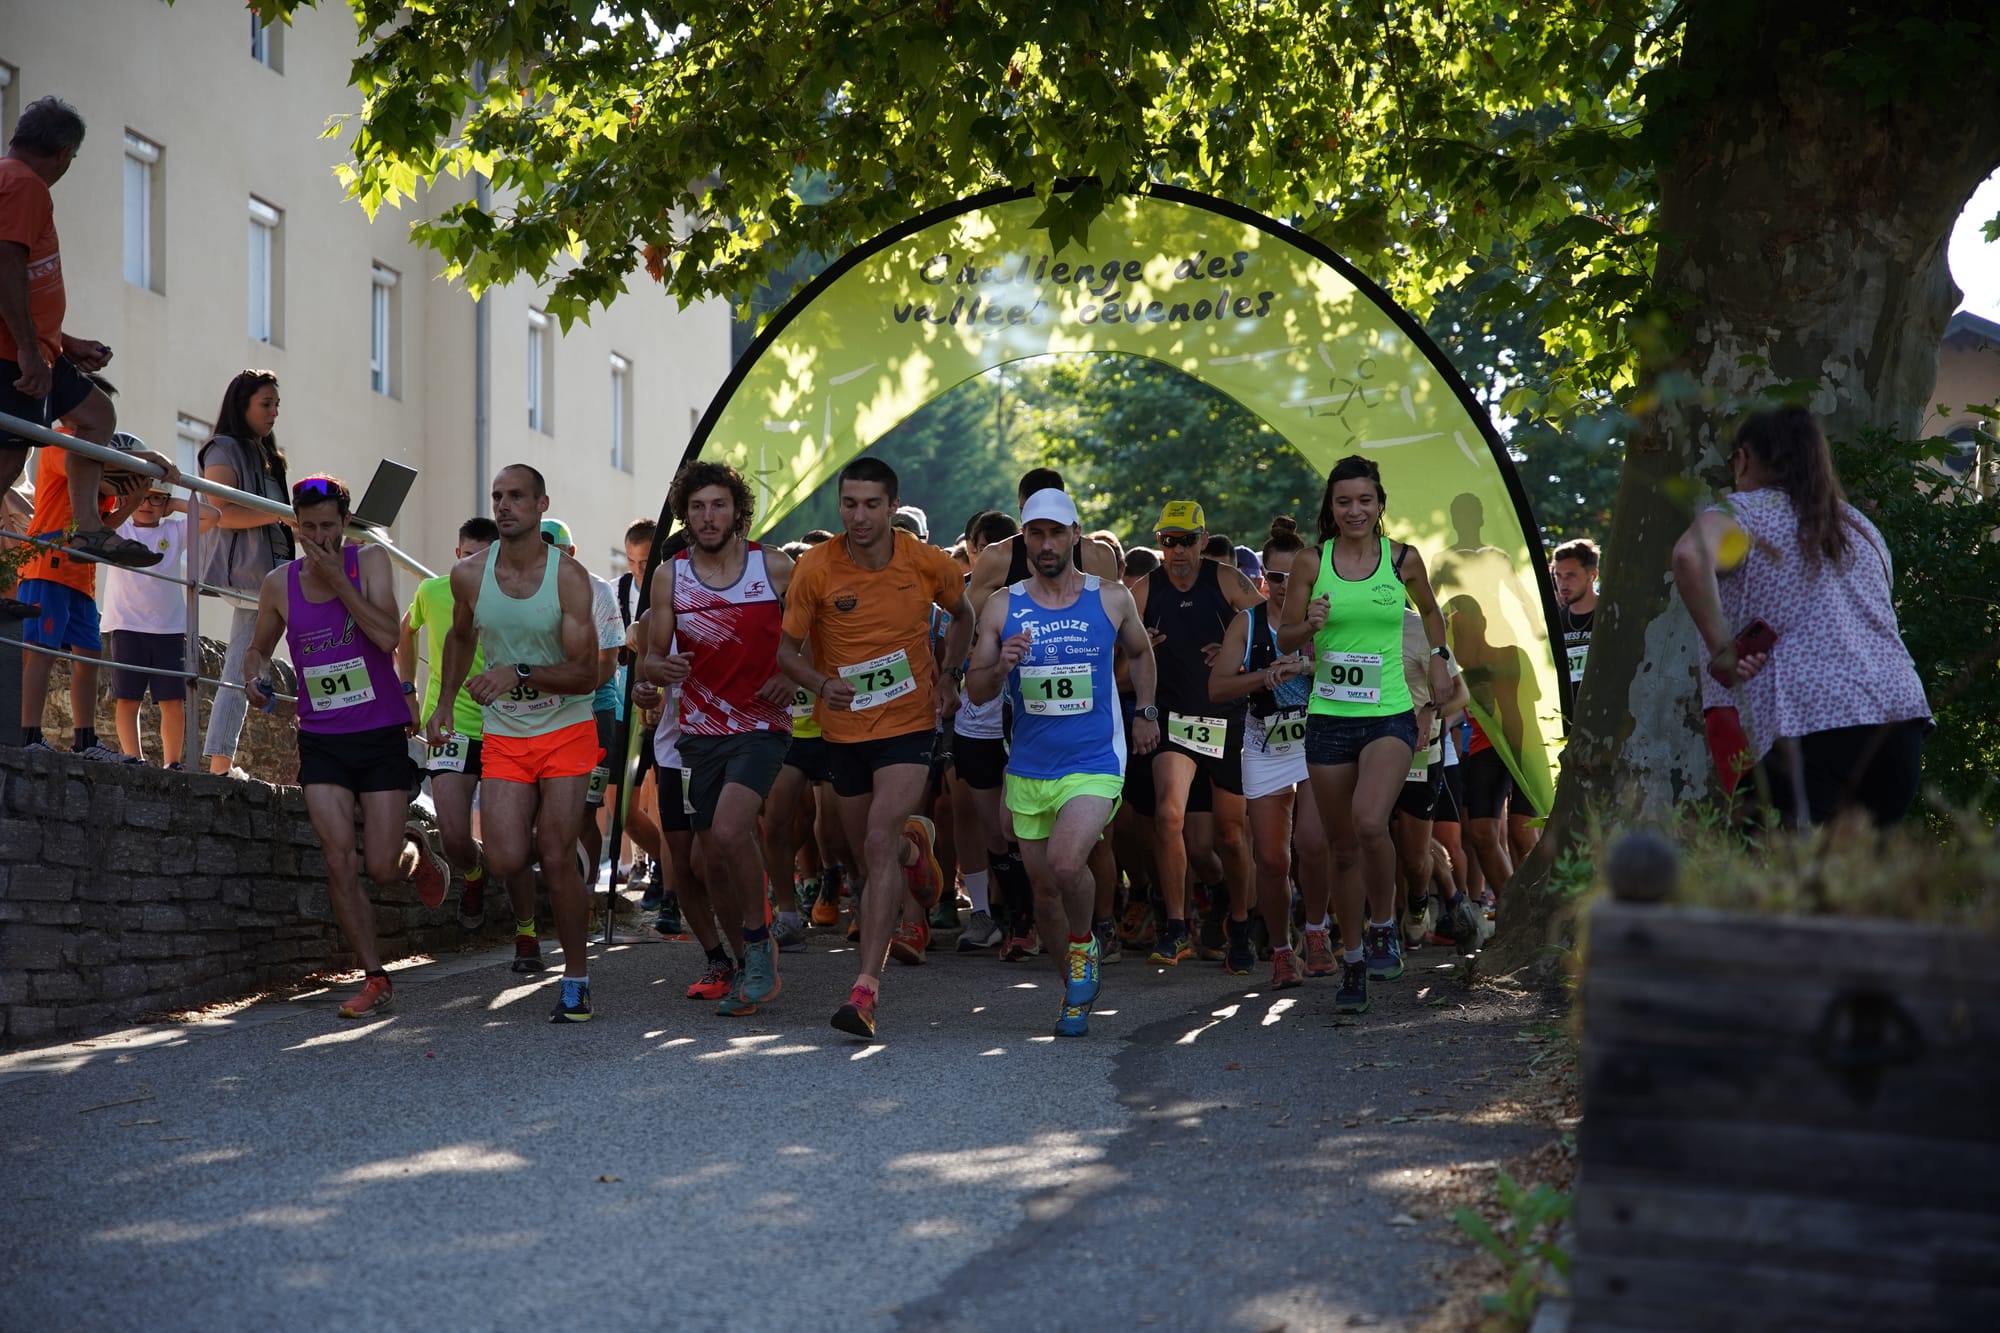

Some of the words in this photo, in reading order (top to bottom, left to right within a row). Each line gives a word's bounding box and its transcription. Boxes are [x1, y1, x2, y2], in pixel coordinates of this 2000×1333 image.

[920, 254, 1143, 296] Challenge
[1175, 250, 1248, 280] des
[1079, 290, 1274, 324] cévenoles
[321, 673, 351, 695] 91
[859, 669, 894, 691] 73
[1331, 665, 1363, 686] 90
[1040, 678, 1073, 699] 18
[1184, 725, 1209, 742] 13
